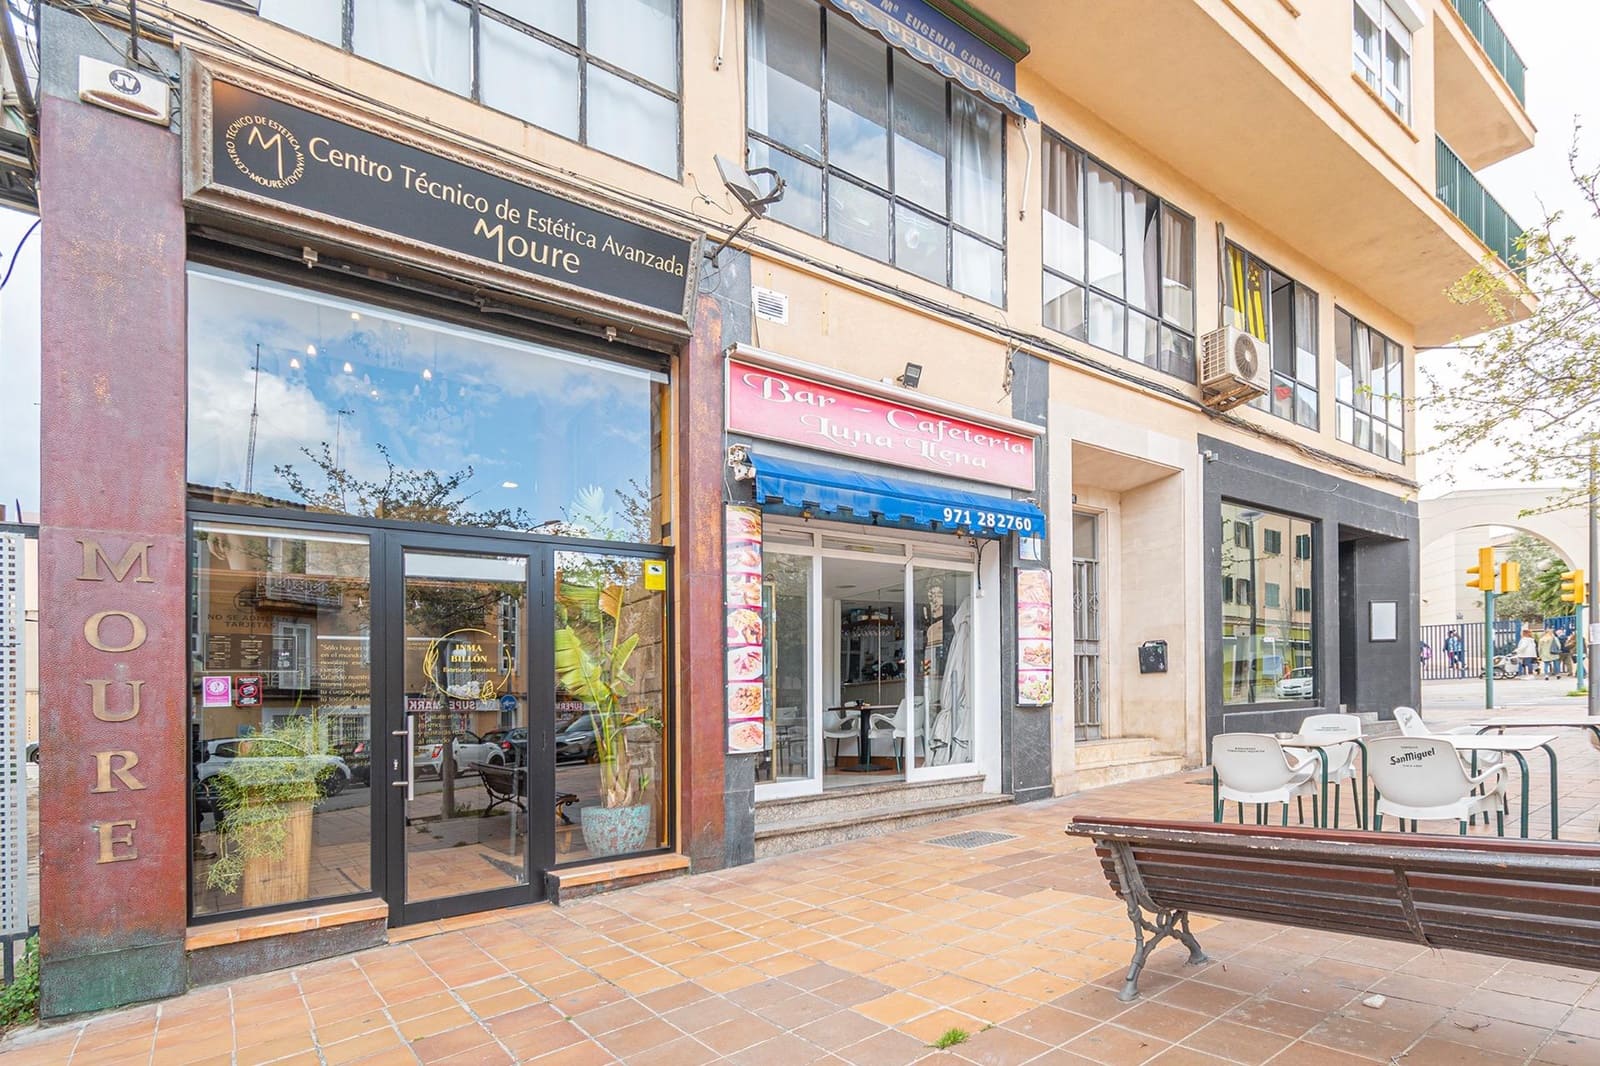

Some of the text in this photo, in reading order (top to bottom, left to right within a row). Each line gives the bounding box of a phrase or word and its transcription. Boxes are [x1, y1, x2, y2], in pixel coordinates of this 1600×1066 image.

[886, 18, 1021, 109] PELUQUERIA
[905, 12, 957, 53] EUGENIA
[960, 48, 1002, 82] GARCIA
[225, 141, 249, 174] CENTRO
[254, 115, 268, 126] DE
[308, 136, 685, 278] Centro Técnico de Estética Avanzada
[473, 217, 581, 275] Moure
[743, 372, 836, 408] Bar
[800, 413, 987, 469] Luna Llena
[943, 507, 1032, 532] 971 282760
[451, 653, 488, 662] BILLÓN
[455, 644, 482, 652] INMA
[75, 538, 156, 866] MOURE
